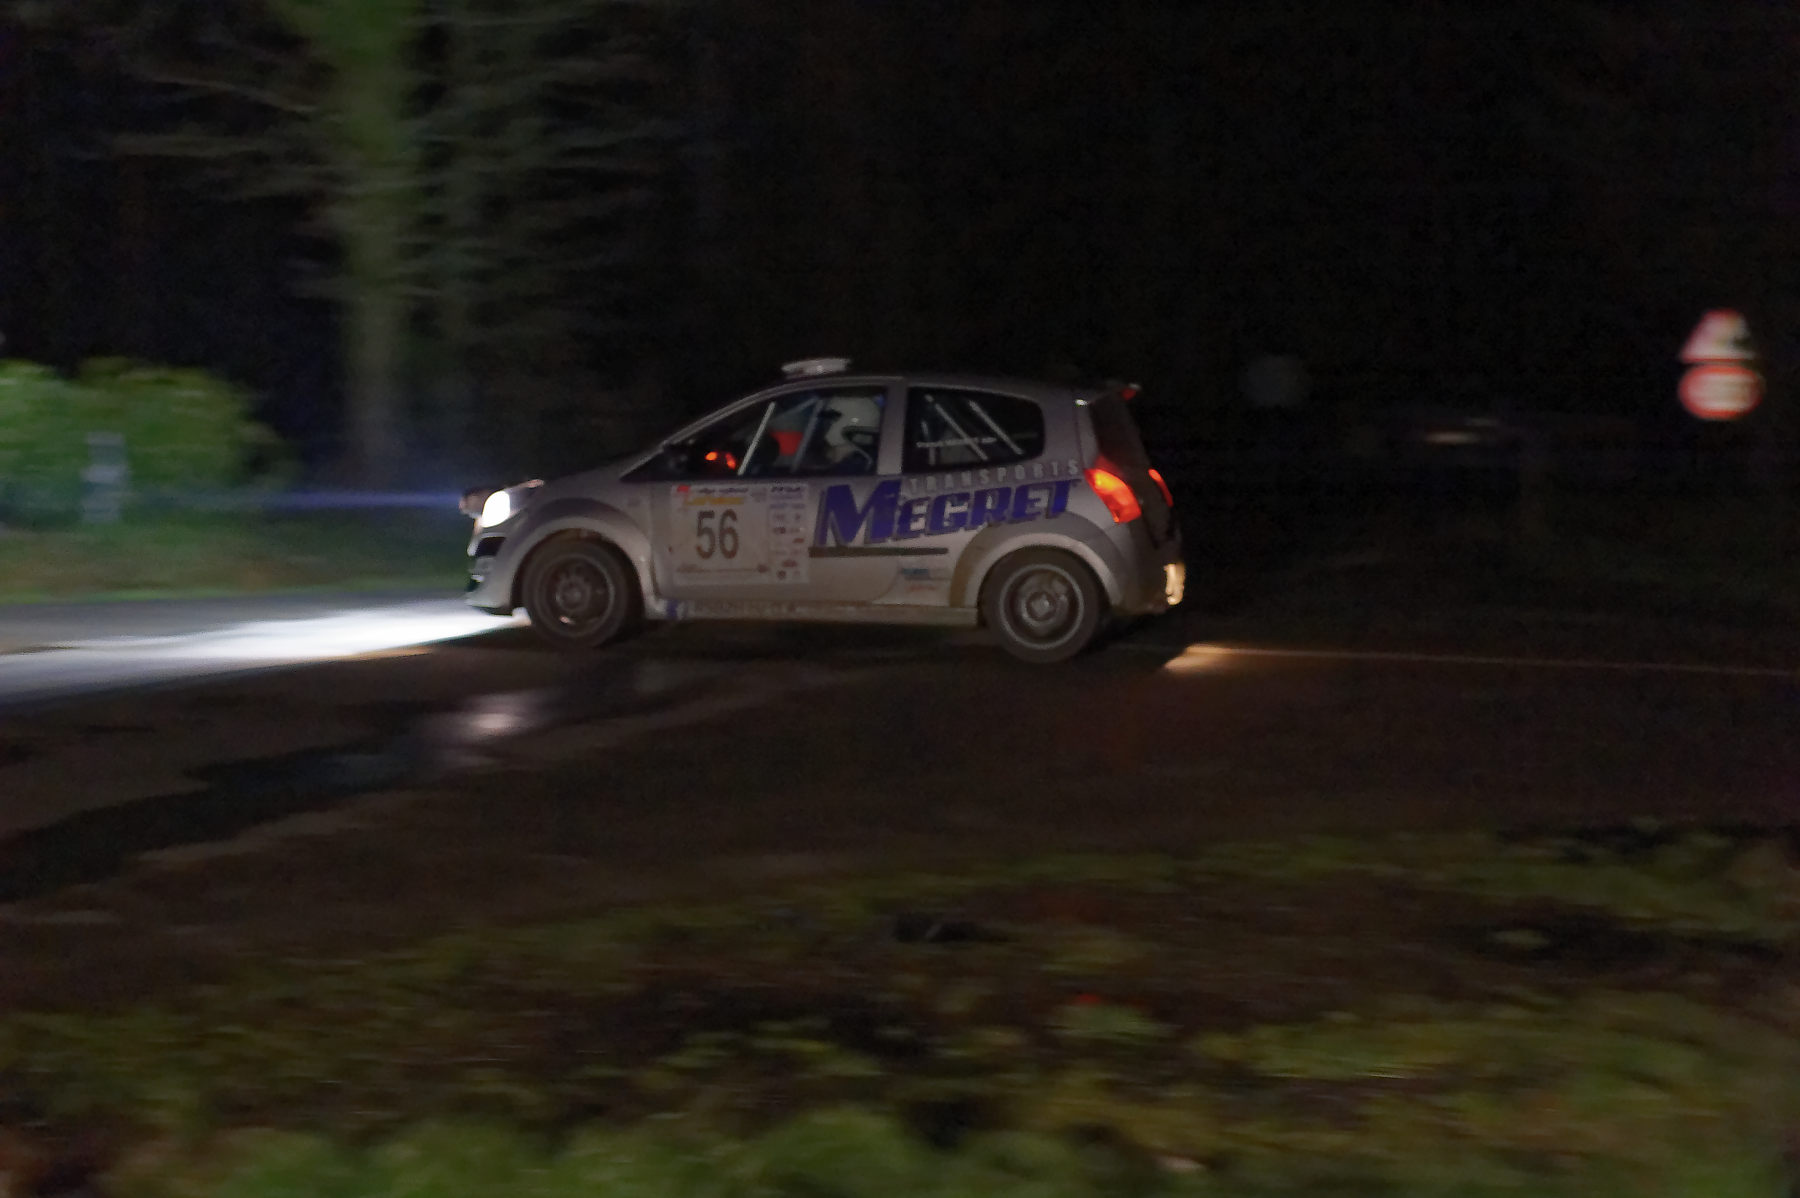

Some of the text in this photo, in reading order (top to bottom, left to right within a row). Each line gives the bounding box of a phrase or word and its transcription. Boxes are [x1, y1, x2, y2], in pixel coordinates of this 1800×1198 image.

[909, 459, 1080, 494] TRANSPORTS
[696, 508, 740, 560] 56
[813, 479, 1077, 546] MEGRET
